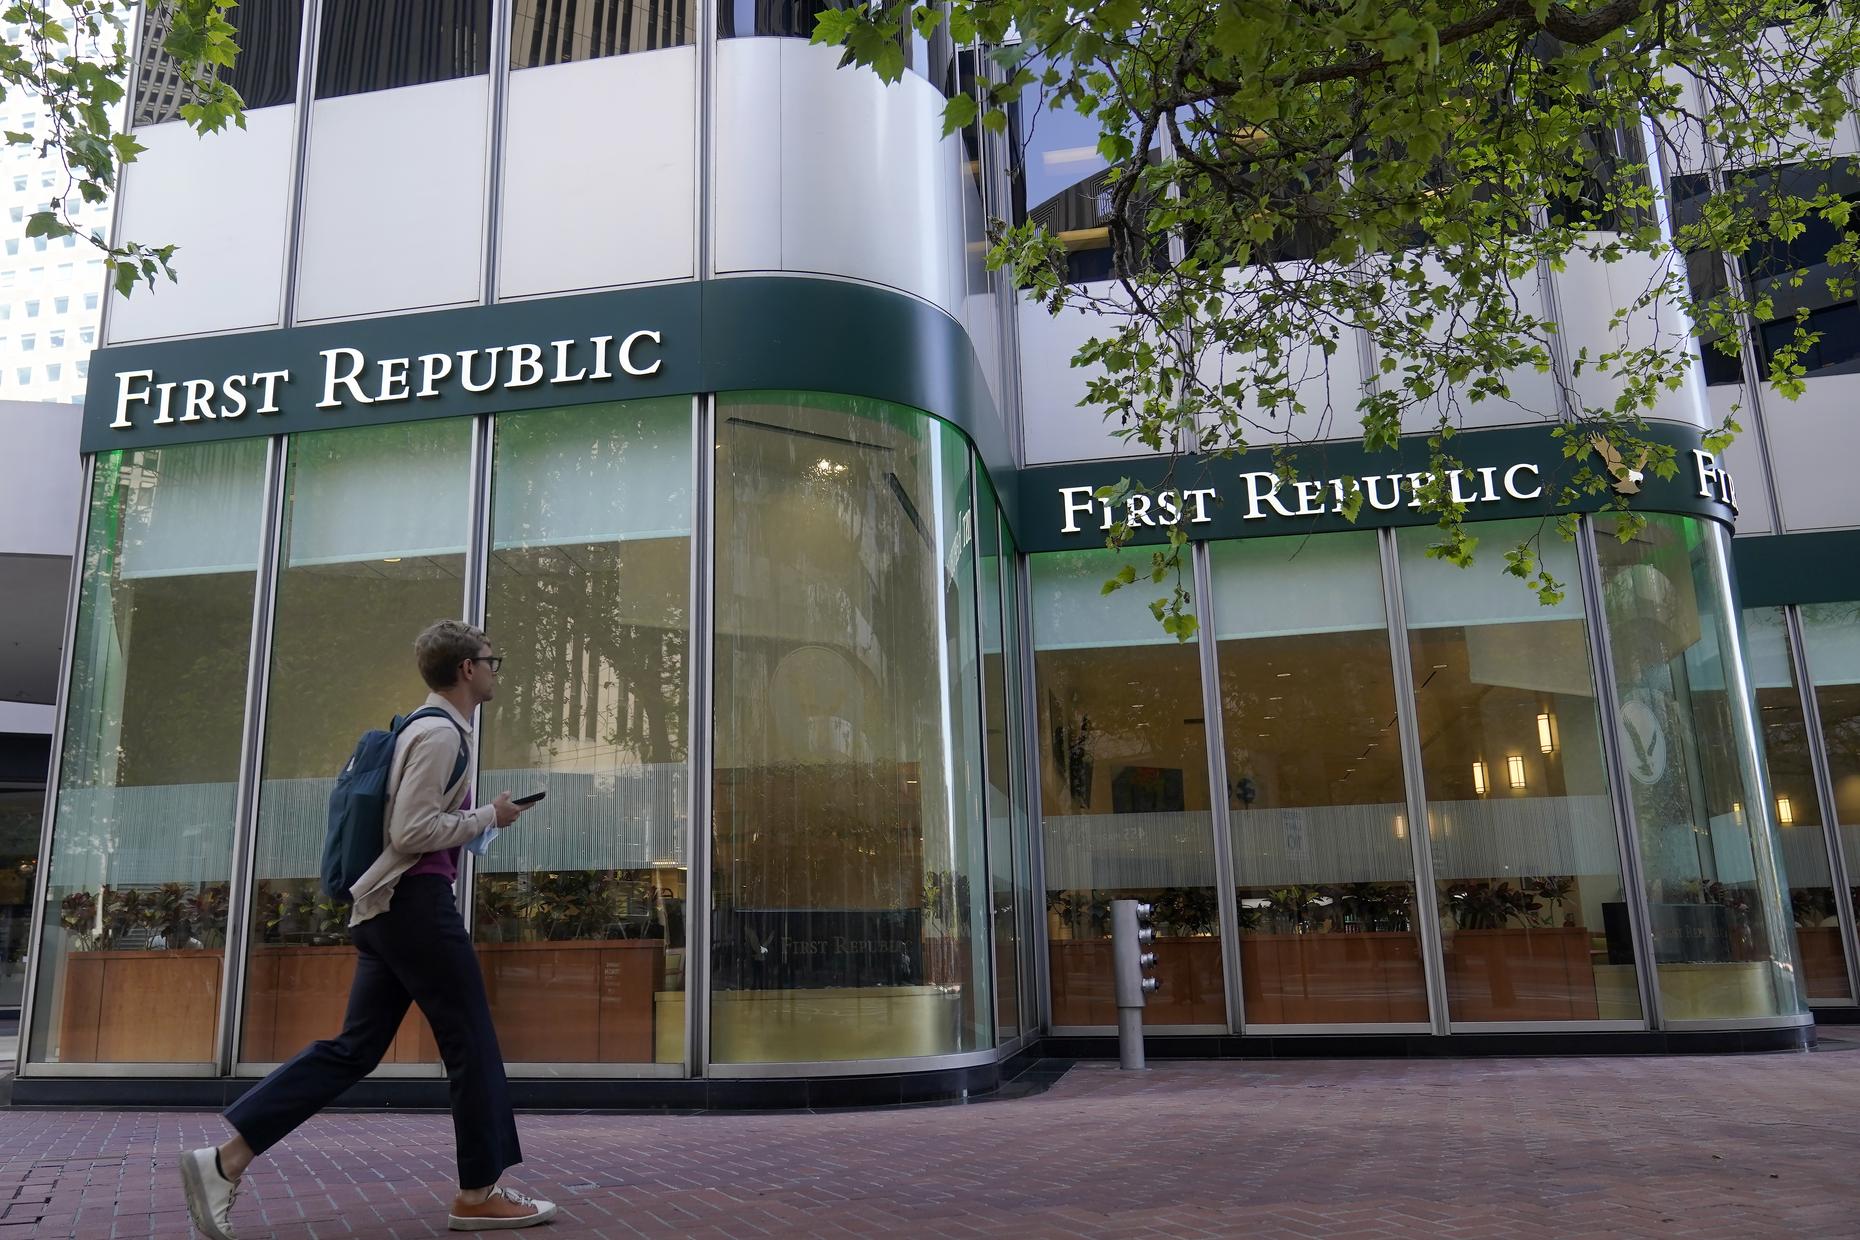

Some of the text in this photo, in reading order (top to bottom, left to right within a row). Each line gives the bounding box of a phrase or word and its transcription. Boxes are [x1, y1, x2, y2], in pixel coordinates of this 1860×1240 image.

[109, 329, 662, 428] FIRST REPUBLIC
[1058, 486, 1216, 532] FIRST
